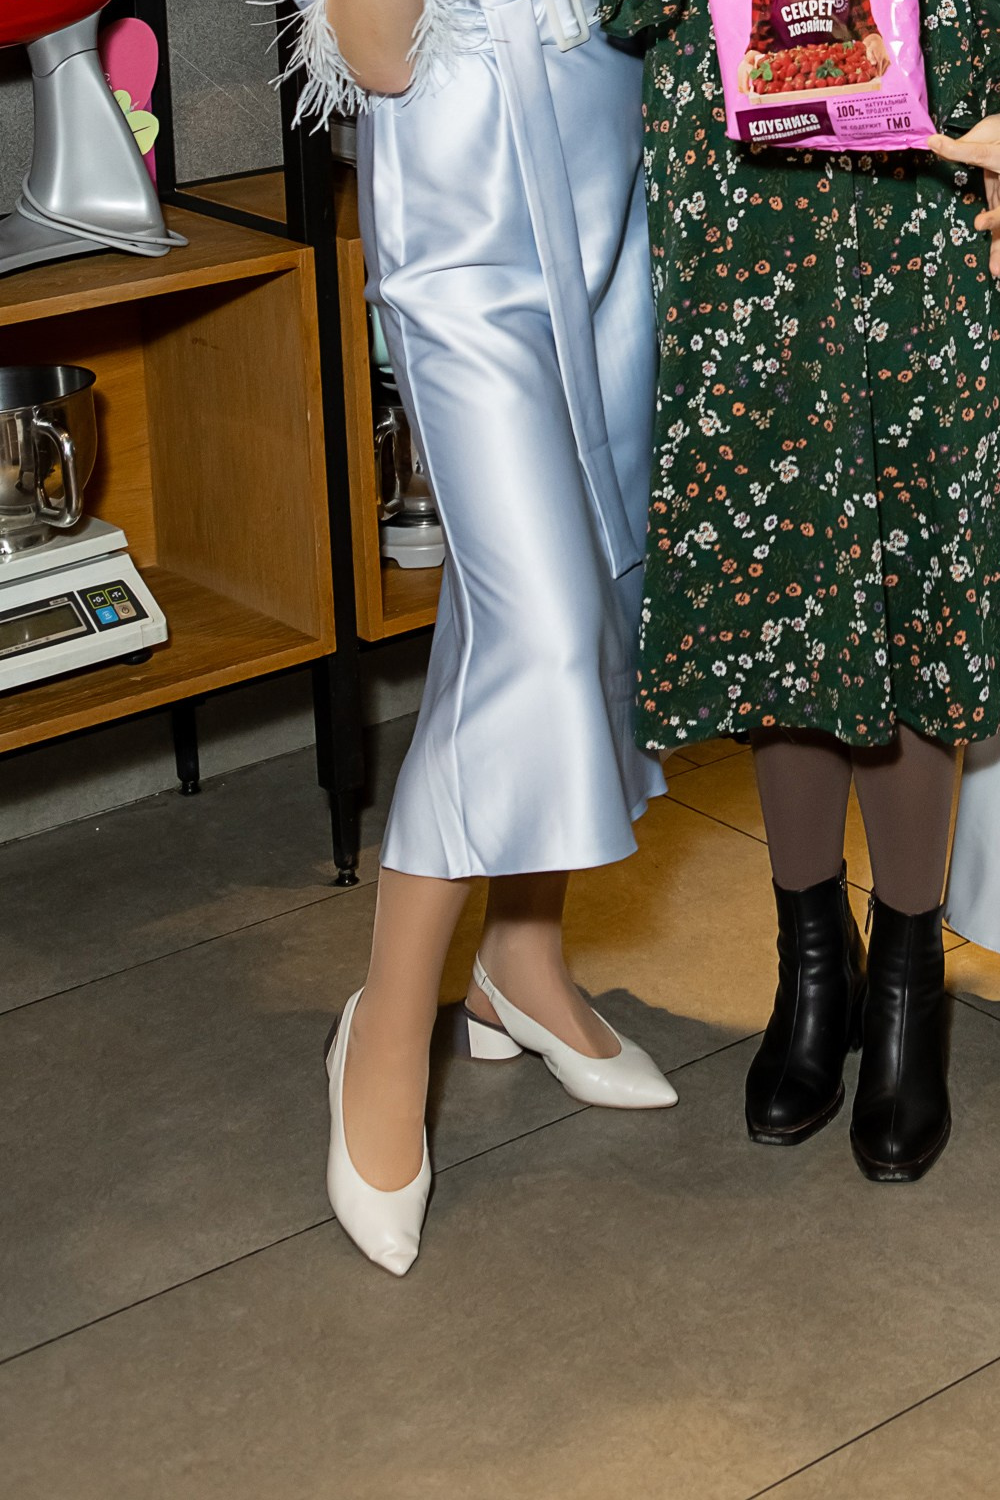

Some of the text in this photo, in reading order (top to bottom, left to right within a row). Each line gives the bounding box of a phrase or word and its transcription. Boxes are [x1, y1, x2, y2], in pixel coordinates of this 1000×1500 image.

[780, 0, 836, 23] СЕКРЕТ
[788, 19, 833, 38] ХОЗЯЙКИ
[836, 97, 907, 118] 100% НАТУРАЛЬНЫЙ
[866, 106, 893, 115] ПРОДУКТ
[850, 122, 882, 131] СОДЕРЖИТ
[886, 116, 911, 130] ГМО
